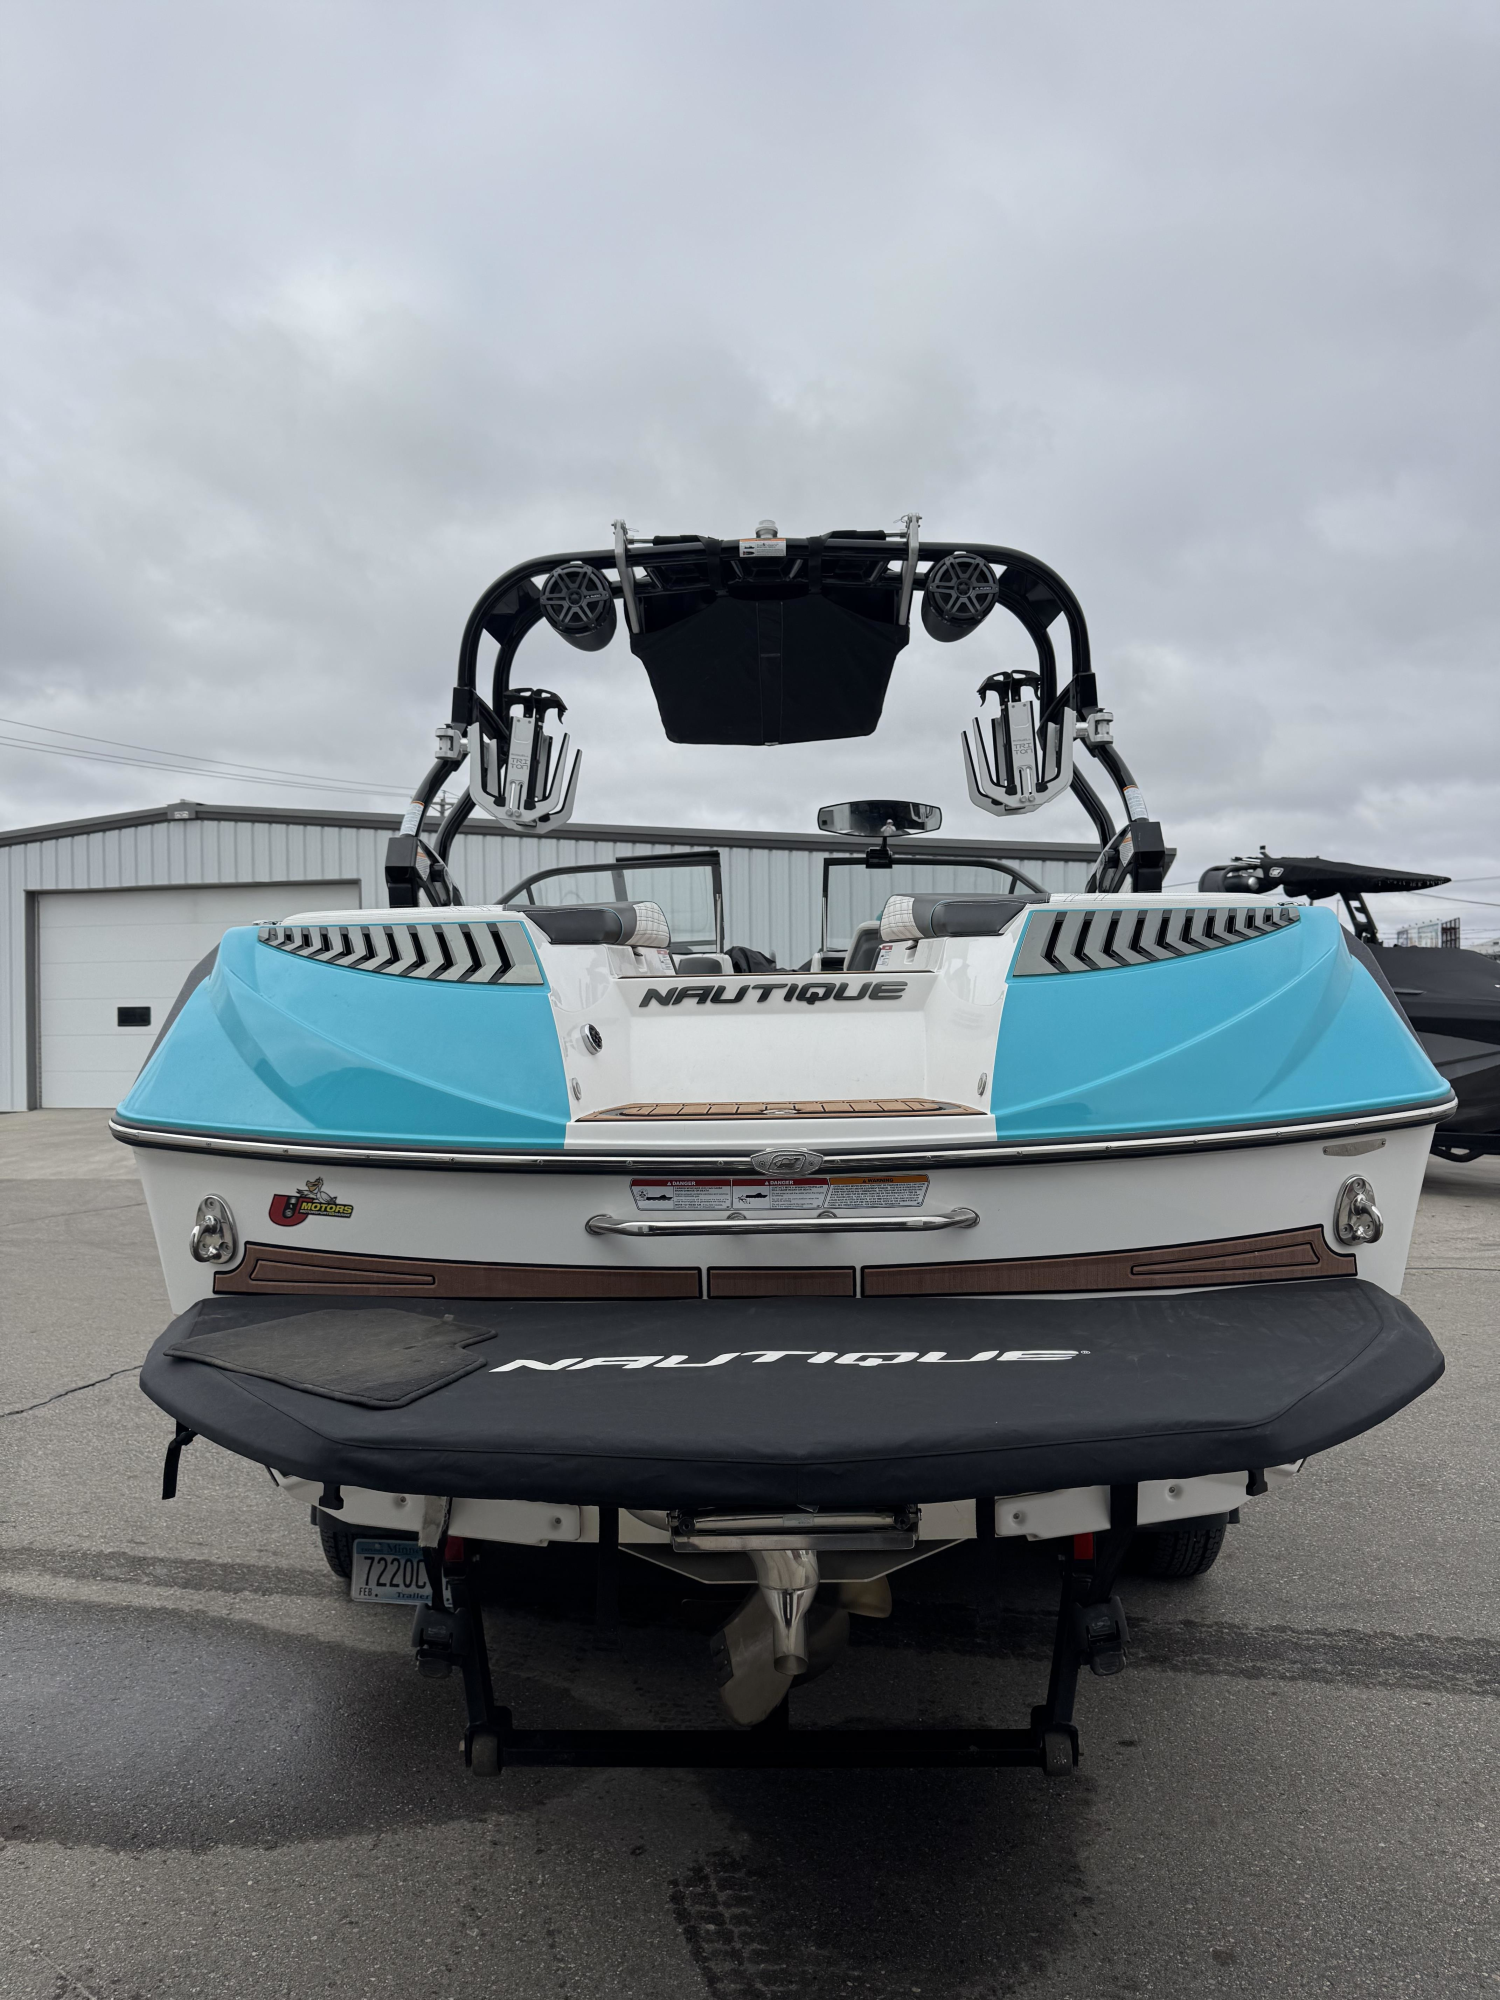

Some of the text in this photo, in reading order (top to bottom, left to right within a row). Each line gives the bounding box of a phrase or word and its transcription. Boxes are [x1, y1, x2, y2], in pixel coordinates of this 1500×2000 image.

[638, 980, 908, 1008] NAUTIQUE
[301, 1202, 353, 1213] MOTORS
[488, 1350, 1079, 1373] NAUTIQUE
[386, 1542, 422, 1554] Minne
[359, 1587, 431, 1600] FEB Trailer
